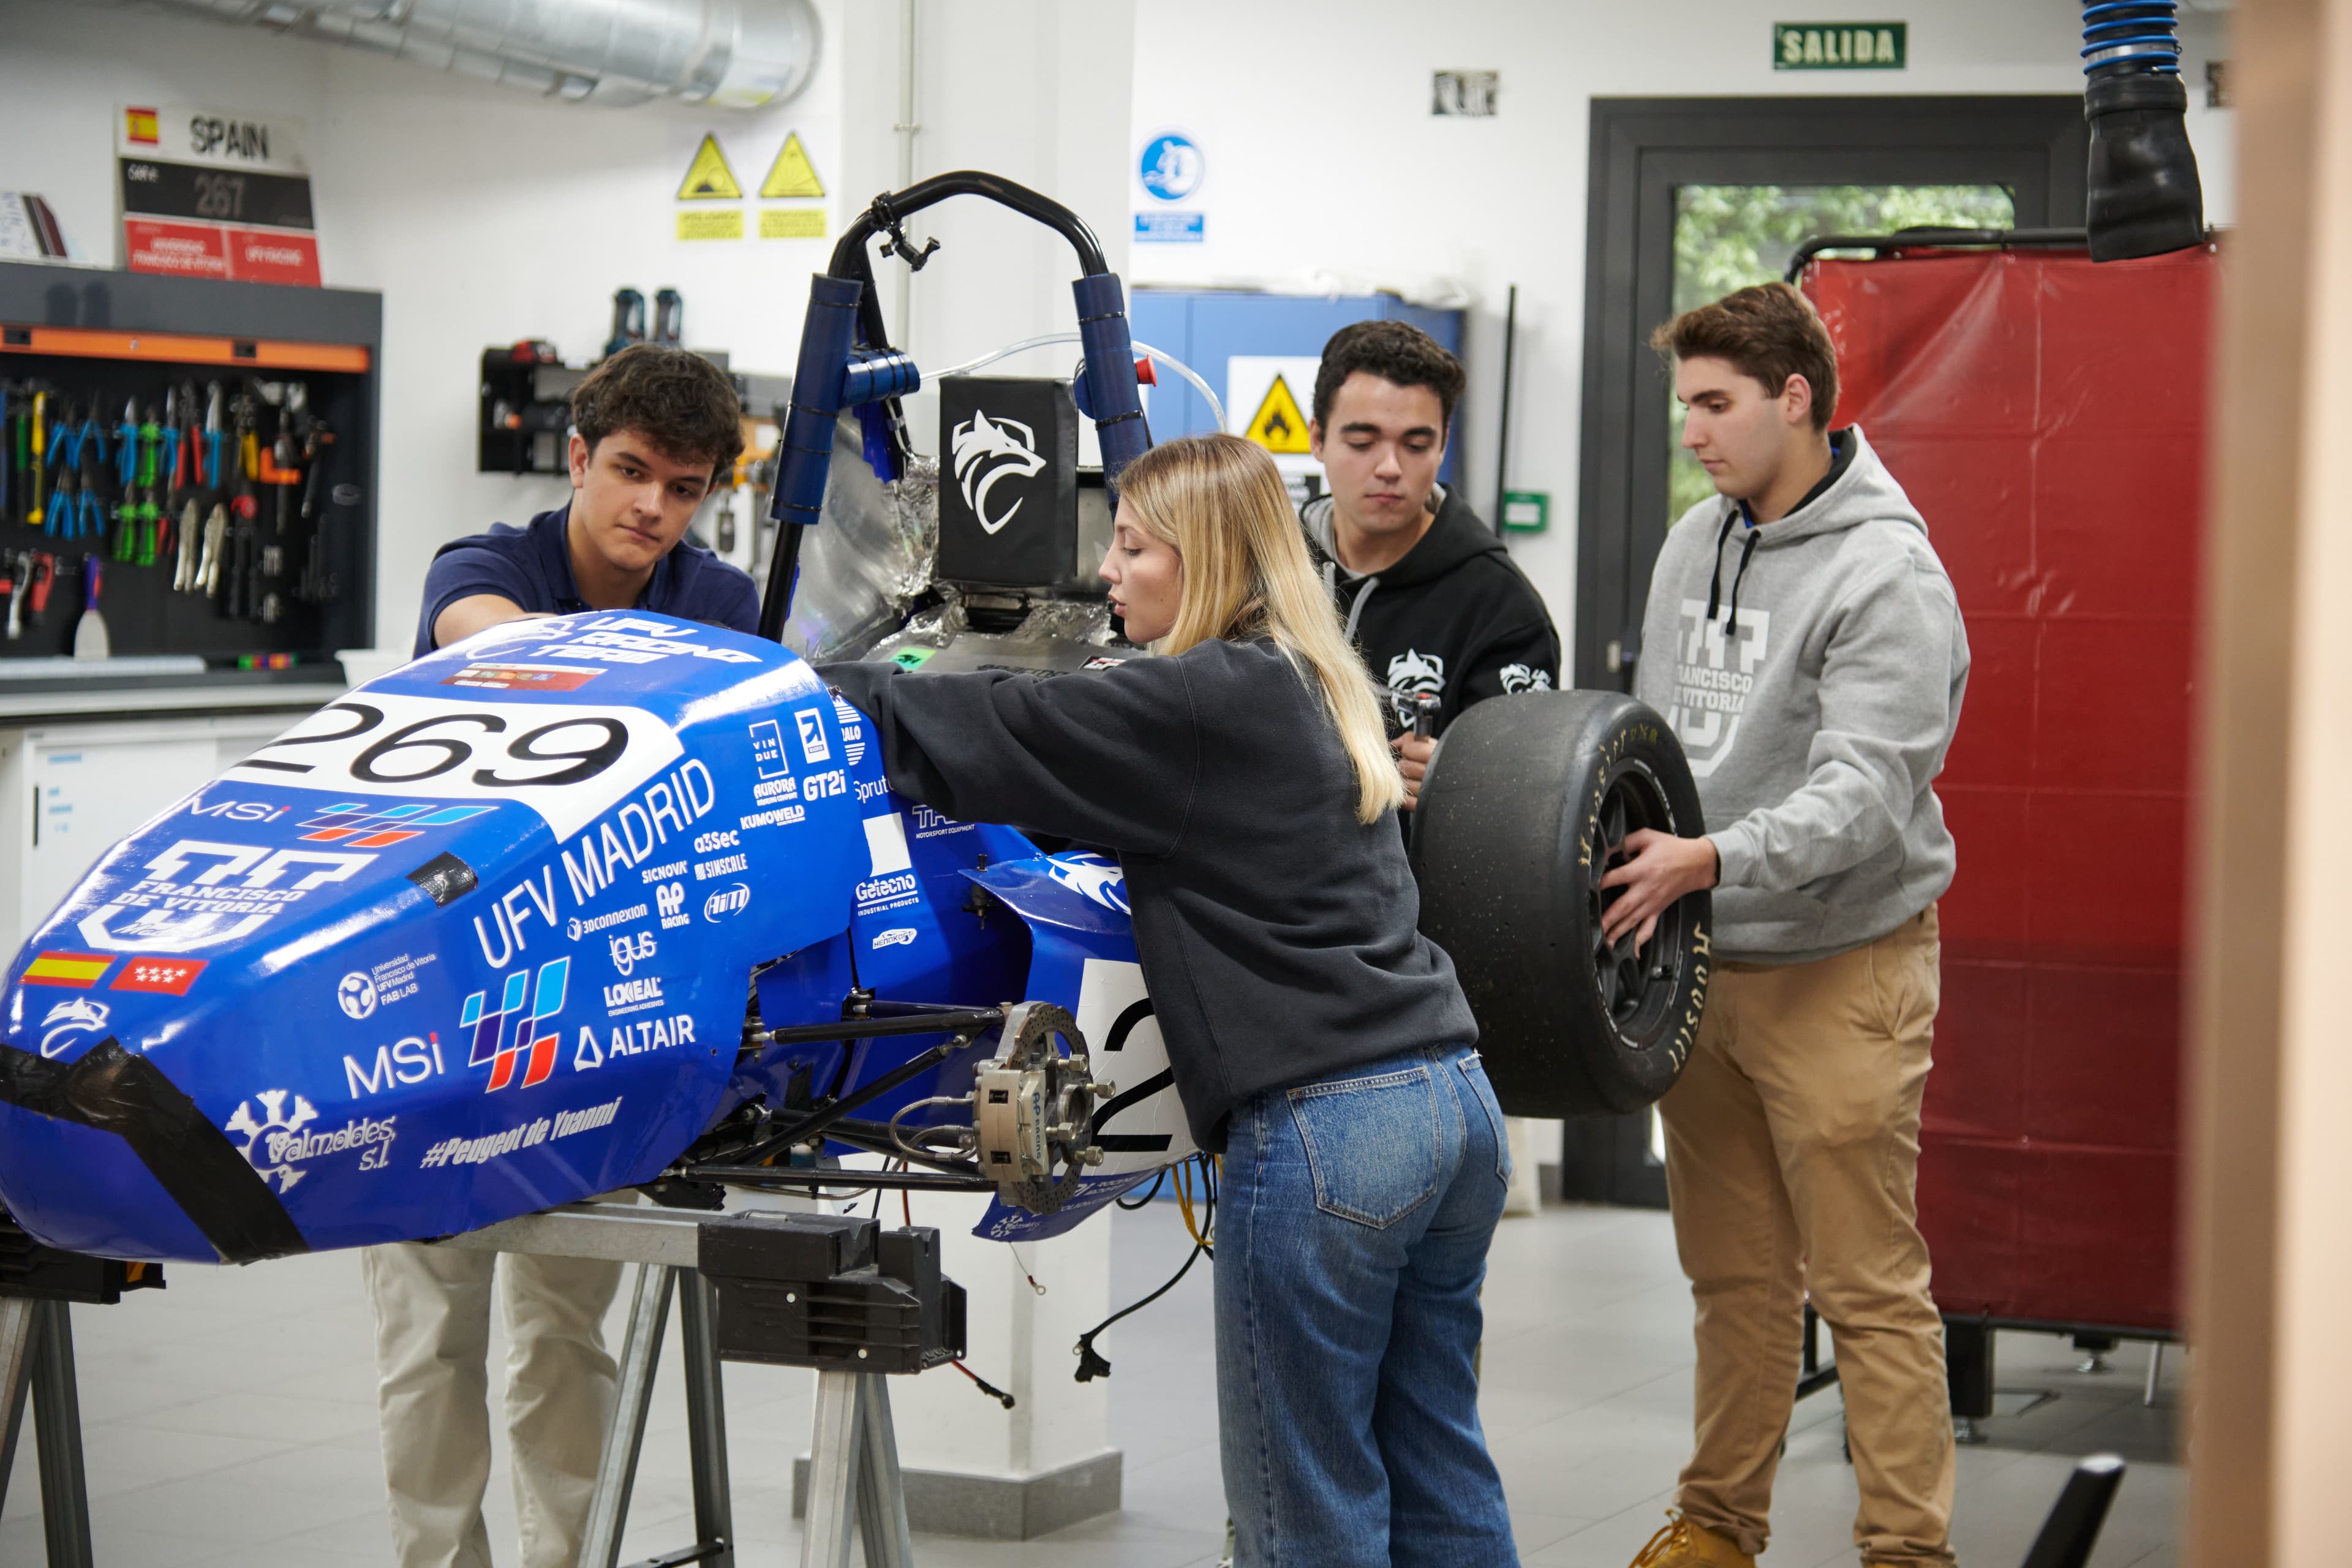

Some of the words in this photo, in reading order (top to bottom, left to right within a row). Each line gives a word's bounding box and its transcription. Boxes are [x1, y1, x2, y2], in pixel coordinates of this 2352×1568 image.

[1782, 29, 1896, 64] SALIDA
[189, 116, 268, 159] SPAIN
[194, 173, 246, 217] 267
[578, 617, 699, 637] UFV
[528, 644, 670, 664] TEAM
[567, 631, 763, 663] RACING
[233, 703, 629, 788] 269
[753, 737, 776, 750] VIN
[755, 749, 778, 762] DUE
[753, 777, 797, 799] AURORA
[803, 769, 847, 802] GT2i
[179, 797, 292, 823] MSi
[740, 804, 805, 830] KUMOWELD
[916, 827, 948, 839] MOTORSPORT
[948, 824, 975, 834] EQUIPMENT
[473, 865, 557, 968] UFV
[560, 758, 715, 907] MADRID
[641, 861, 687, 884] SICNOVA
[705, 853, 748, 878] SIMSCALE
[128, 880, 308, 902] FRANCISCO
[656, 881, 684, 917] AP
[855, 874, 916, 901] Getecno
[110, 893, 160, 907] DE
[163, 897, 285, 914] VITORIA
[858, 905, 889, 916] INDUSTRIAL
[890, 897, 919, 910] PRODUCTS
[661, 913, 690, 930] RACING
[372, 953, 409, 975] Universidad
[609, 931, 657, 976] igus
[374, 966, 405, 983] Francisco
[405, 962, 415, 971] de
[414, 954, 435, 967] Vitoria
[377, 979, 391, 992] UFV
[392, 971, 414, 986] Madrid
[380, 990, 400, 1006] FAB
[399, 982, 418, 998] LAB
[603, 978, 663, 1007] LOXEAL
[608, 1005, 639, 1017] ENGINEERING
[639, 999, 664, 1010] ADHESIVES
[609, 1014, 696, 1058] ALTAIR
[343, 1031, 445, 1099] MSi
[1033, 1091, 1041, 1117] AP
[420, 1123, 527, 1169] #Peugeot
[522, 1117, 551, 1148] de
[549, 1096, 623, 1141] Yuanmi
